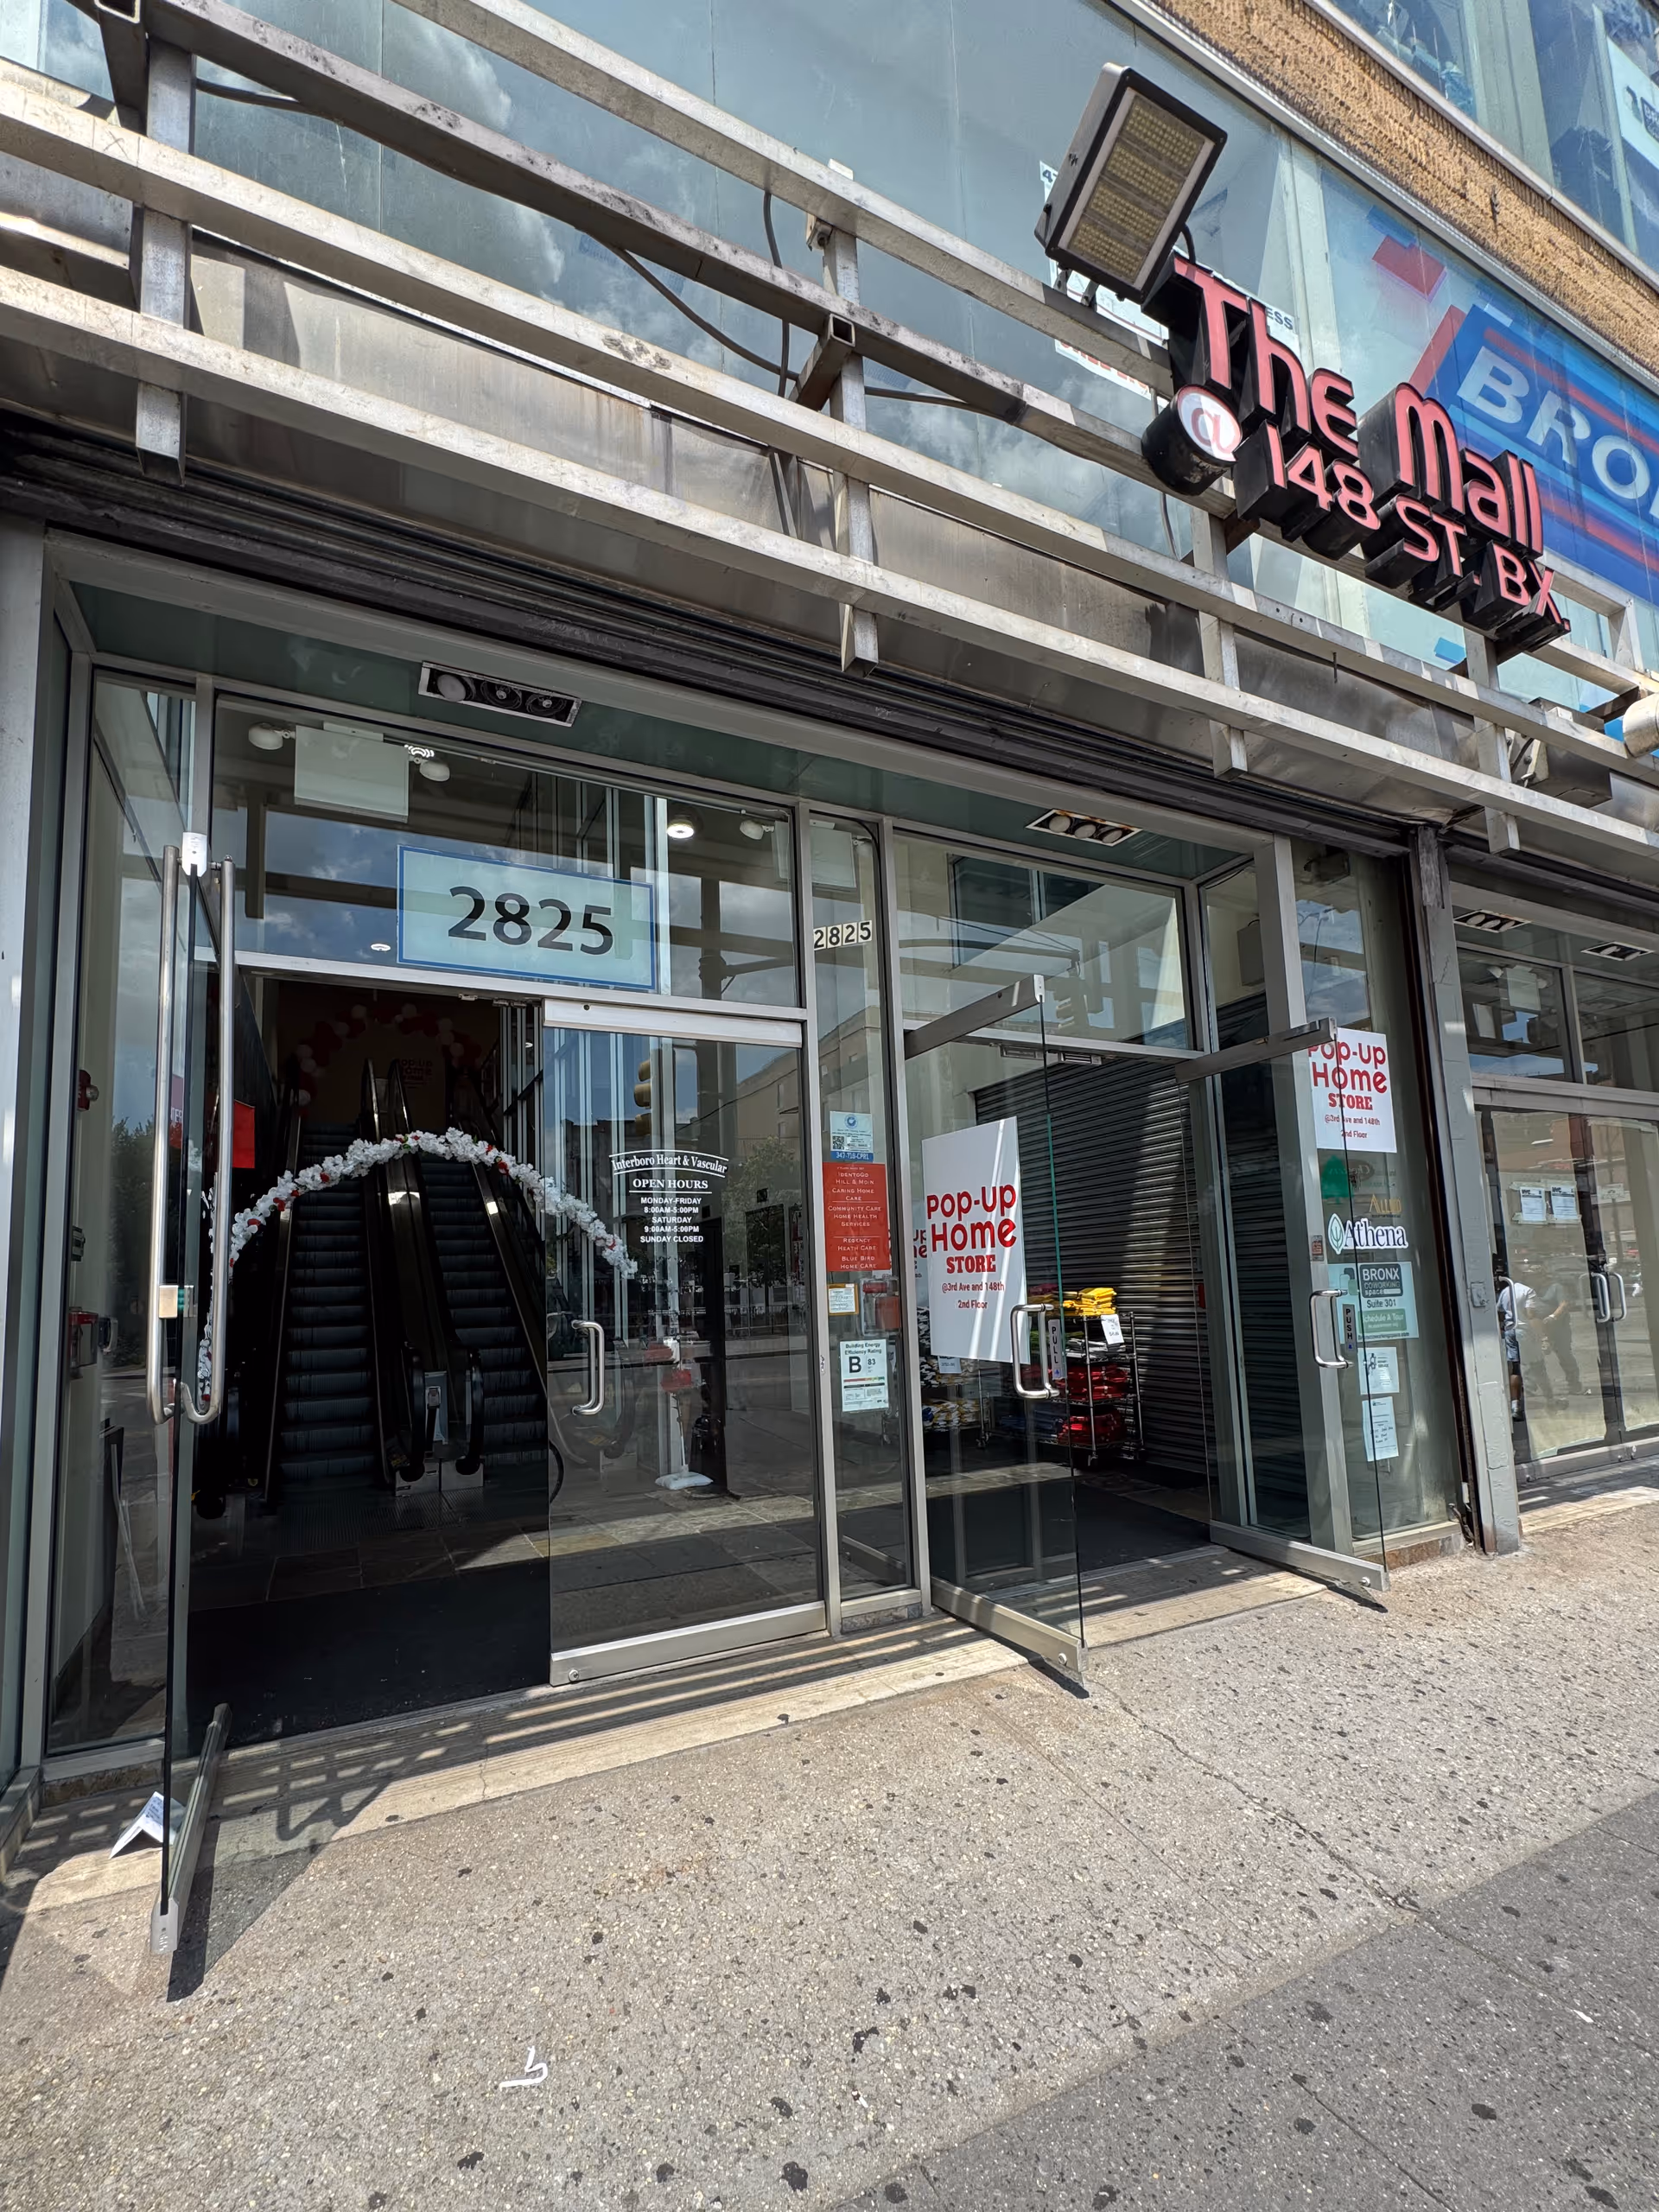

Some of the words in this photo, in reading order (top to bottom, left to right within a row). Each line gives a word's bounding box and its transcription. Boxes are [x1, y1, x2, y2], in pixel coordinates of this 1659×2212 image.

[1173, 256, 1359, 461] The
[1394, 382, 1544, 559] Mall
[1457, 346, 1659, 527] BRO
[1177, 384, 1242, 461] @
[1265, 421, 1381, 530] 148
[448, 885, 614, 956] 2825
[813, 921, 872, 950] 2825
[1312, 1062, 1388, 1094] Home
[1328, 1092, 1374, 1111] STORE
[1325, 1114, 1340, 1124] @3rd
[1364, 1116, 1381, 1126] 148th
[1353, 1130, 1368, 1139] Floor
[611, 1155, 655, 1171] Interboro
[657, 1154, 682, 1166] Heart
[683, 1154, 690, 1166] &
[691, 1155, 728, 1173] Vascular
[632, 1179, 665, 1189] OPEN
[668, 1179, 709, 1190] HOURS
[926, 1184, 1017, 1221] Pop-up
[931, 1218, 1017, 1252] Home
[1344, 1218, 1407, 1248] Athena
[945, 1254, 996, 1274] STORE
[1362, 1268, 1401, 1281] BRONX
[942, 1281, 958, 1294] @3rd
[958, 1282, 970, 1291] Ave
[971, 1281, 983, 1291] and
[984, 1281, 1005, 1292] 148th
[1363, 1281, 1401, 1290] COWORKING
[957, 1300, 969, 1309] 2nd
[971, 1300, 988, 1309] Floor
[1366, 1300, 1384, 1308] Suite
[1384, 1299, 1396, 1307] 301
[1363, 1313, 1387, 1323] chedule
[849, 1356, 861, 1374] B
